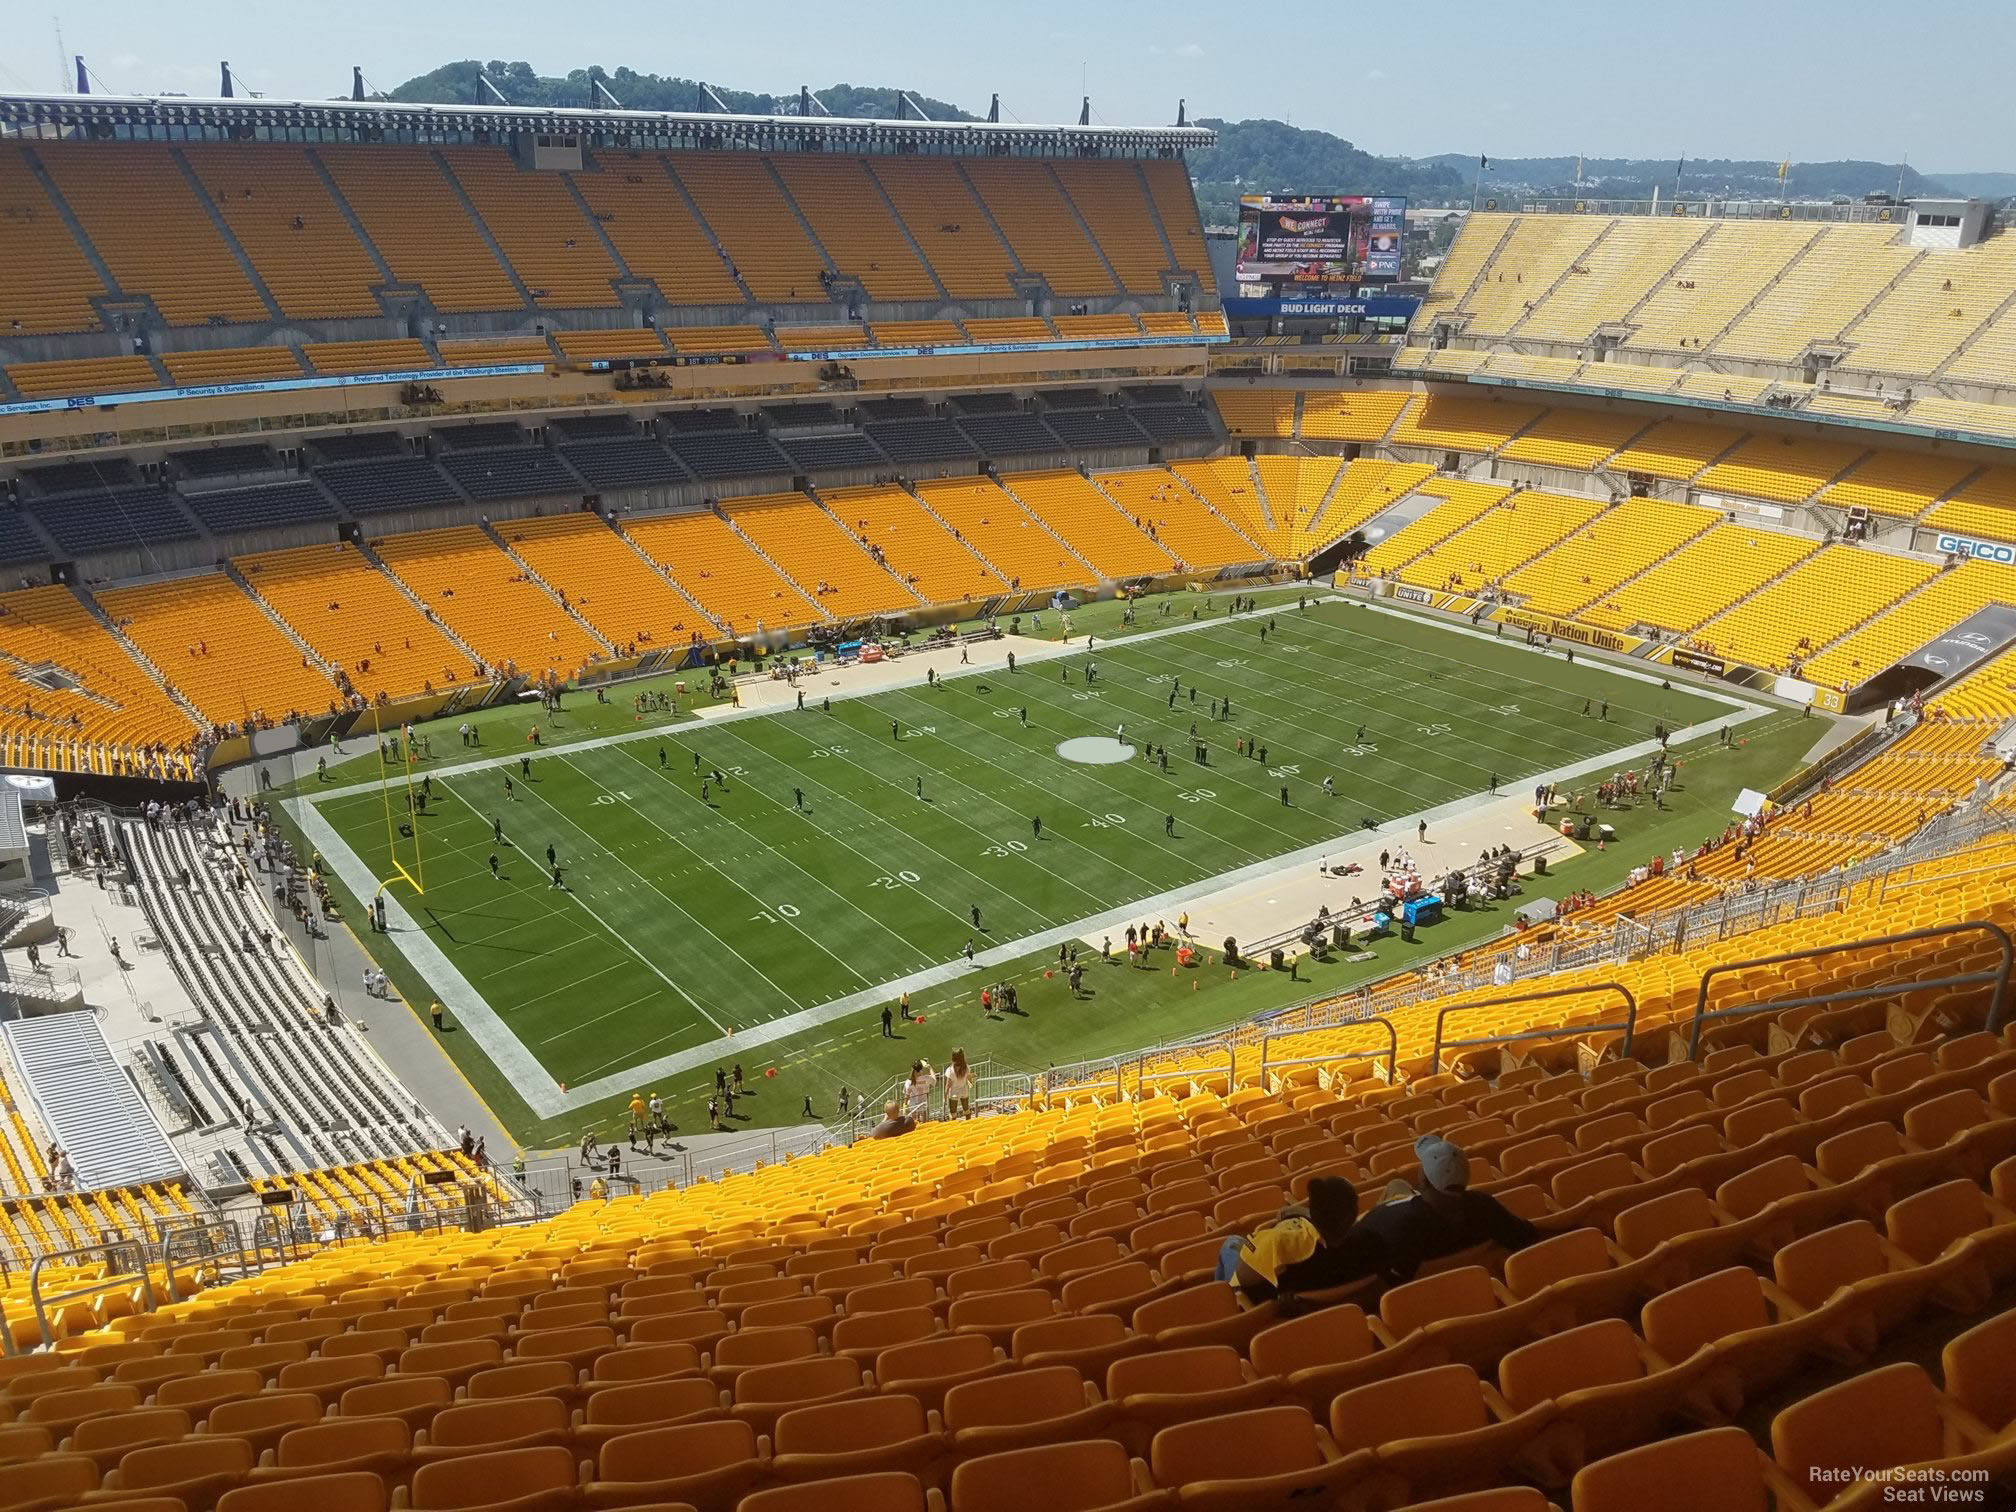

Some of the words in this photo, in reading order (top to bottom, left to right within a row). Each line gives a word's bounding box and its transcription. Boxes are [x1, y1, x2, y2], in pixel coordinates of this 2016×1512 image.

[1379, 261, 1397, 269] PNC
[1281, 304, 1303, 312] BUD
[1304, 304, 1335, 313] LIGHT
[1337, 305, 1365, 313] DECK
[67, 397, 95, 407] DES
[224, 384, 265, 392] Surveillance
[353, 375, 384, 383] Preferred
[385, 372, 418, 381] Technology
[419, 370, 446, 378] Provider
[453, 368, 462, 376] the
[463, 367, 494, 376] Pittsburgh
[1939, 536, 2013, 562] GEICO
[1398, 590, 1423, 601] UNITE
[1504, 609, 1548, 632] Steelers
[1551, 620, 1589, 642] Nation
[1592, 630, 1624, 651] Unite
[1823, 693, 1839, 708] 33
[1177, 788, 1217, 803] 50
[1091, 813, 1126, 828] 40
[987, 840, 1028, 857] 30
[876, 870, 921, 890] 20
[757, 904, 801, 924] 10
